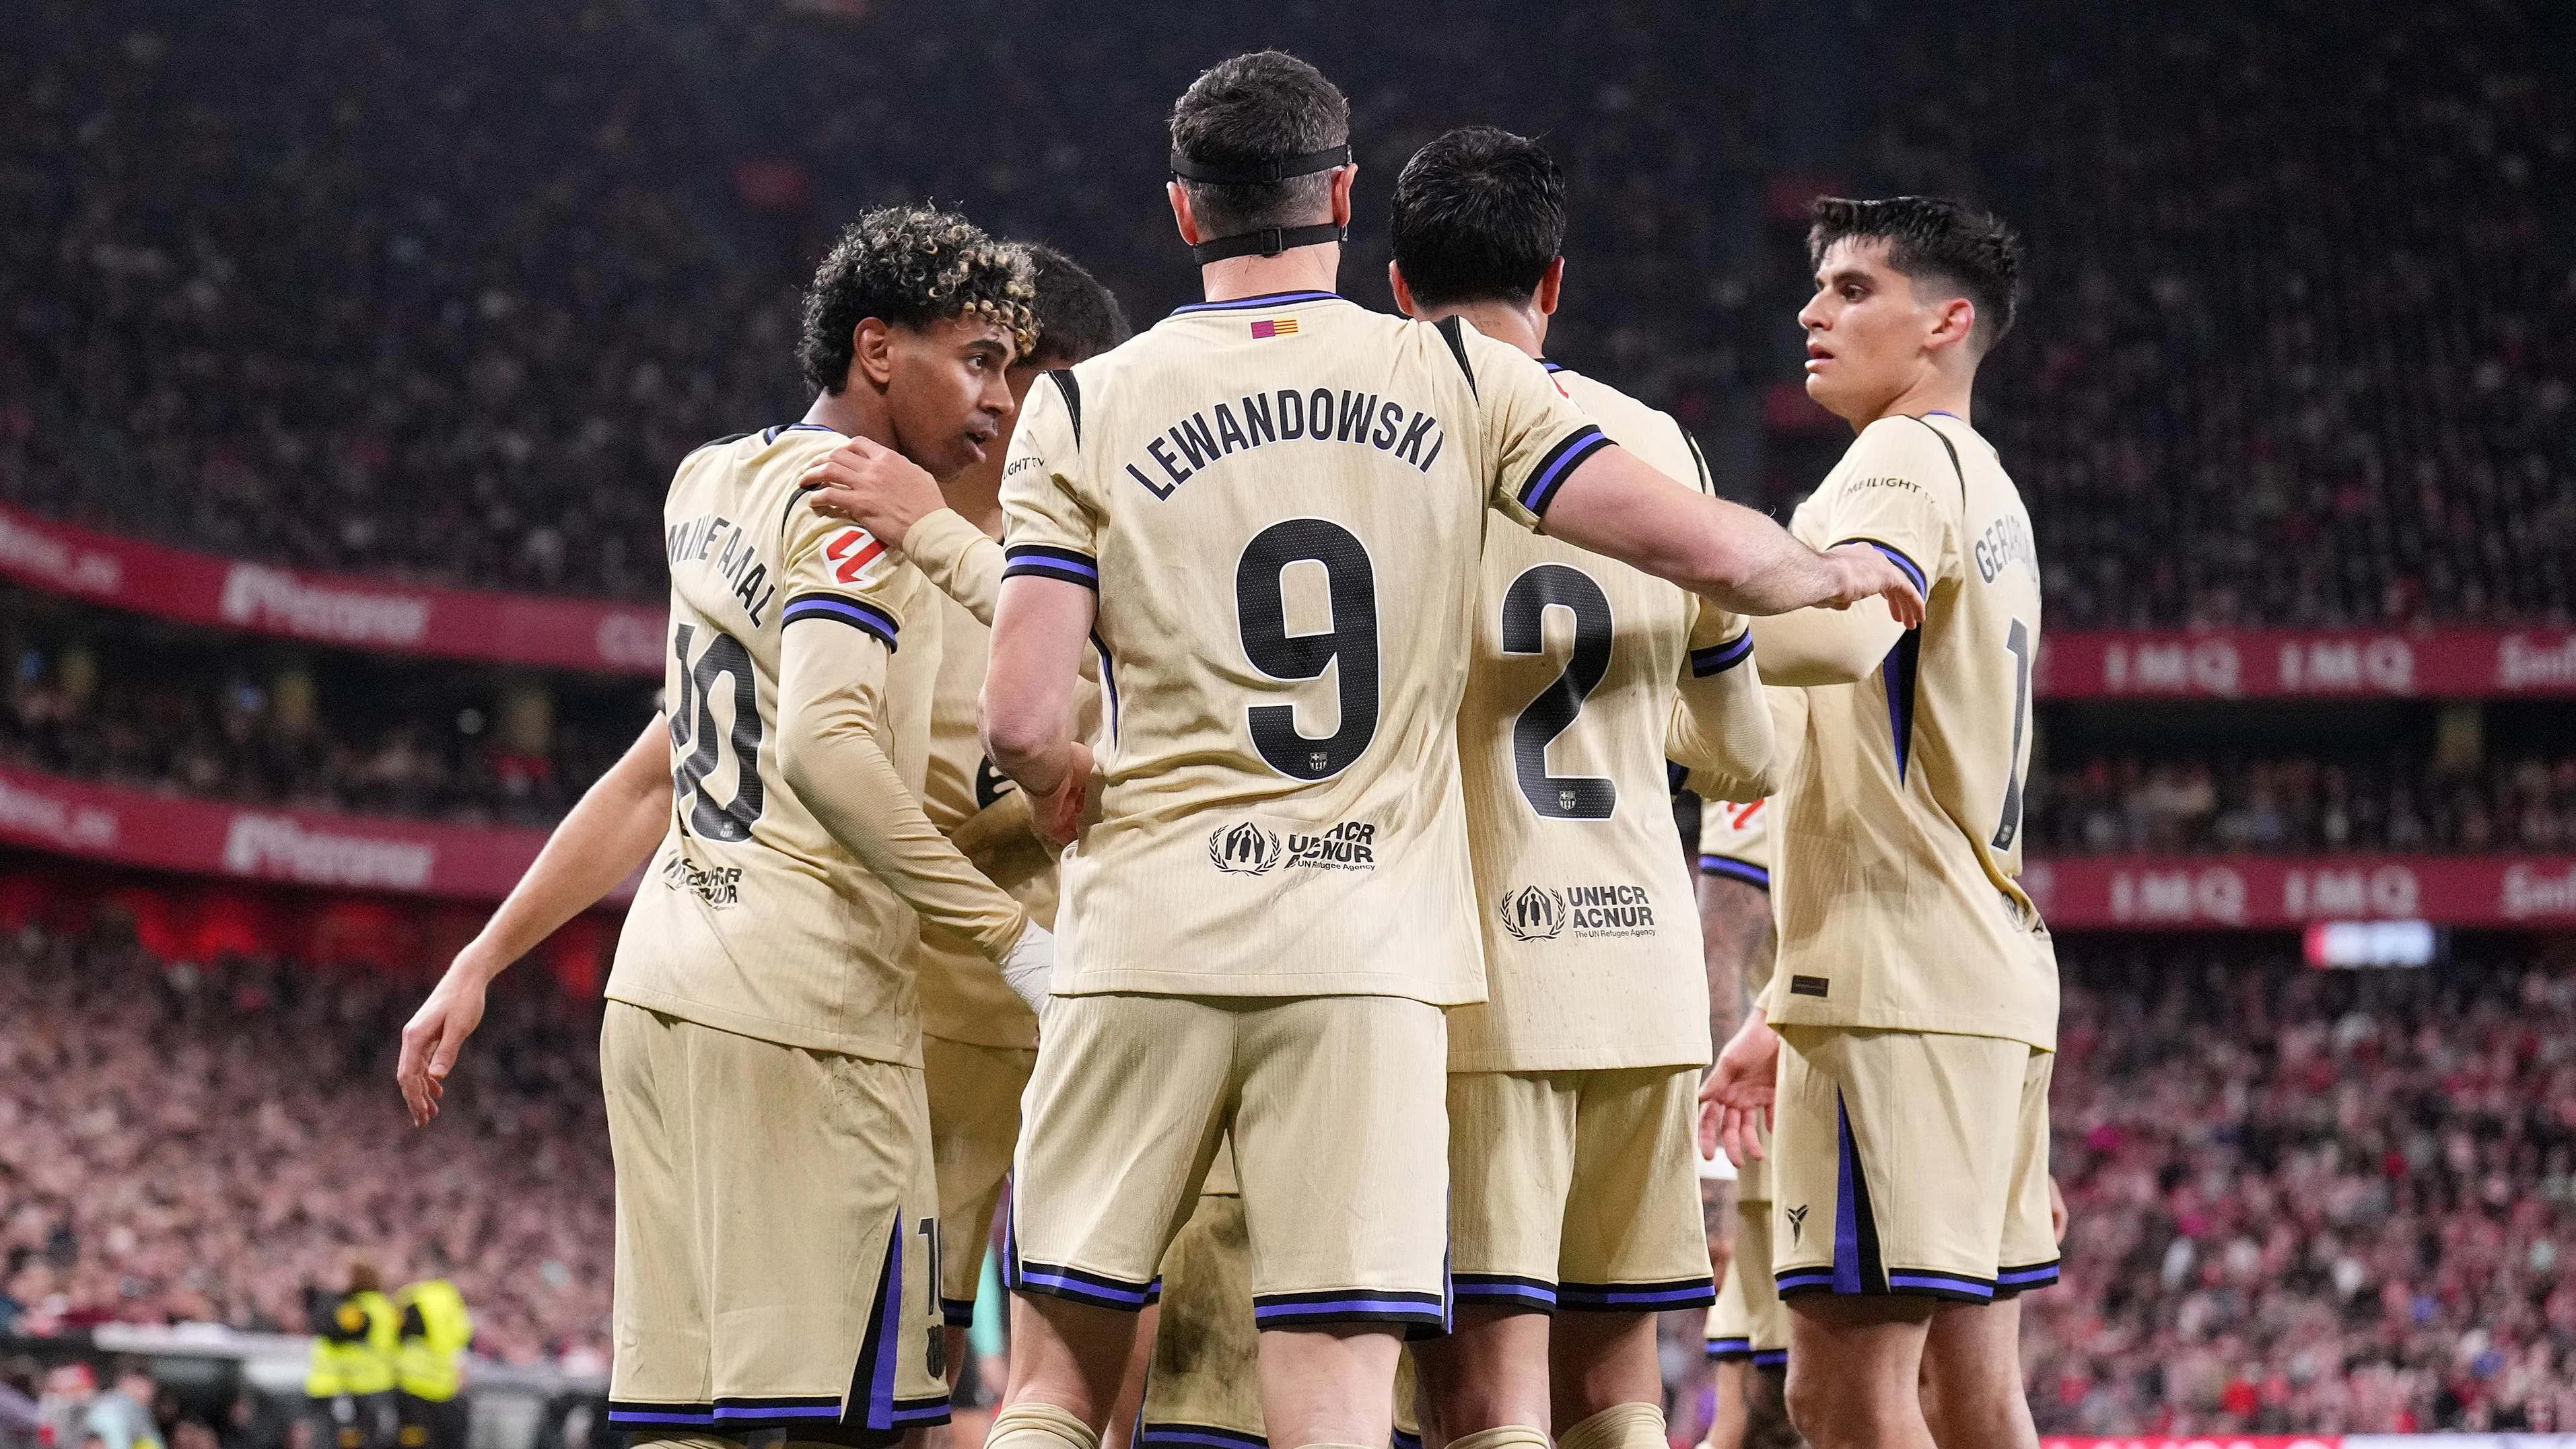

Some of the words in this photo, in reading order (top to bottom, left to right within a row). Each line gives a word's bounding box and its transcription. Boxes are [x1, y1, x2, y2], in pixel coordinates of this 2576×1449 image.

[1123, 386, 1446, 502] LEWANDOWSKI
[1234, 516, 1381, 783] 9
[1500, 563, 1616, 820] 2
[667, 621, 765, 843] 10
[1297, 859, 1312, 868] UN
[1567, 885, 1650, 907] UNHCR
[1573, 907, 1655, 928] ACNUR
[1601, 930, 1630, 938] Refugee
[918, 1217, 944, 1316] 1
